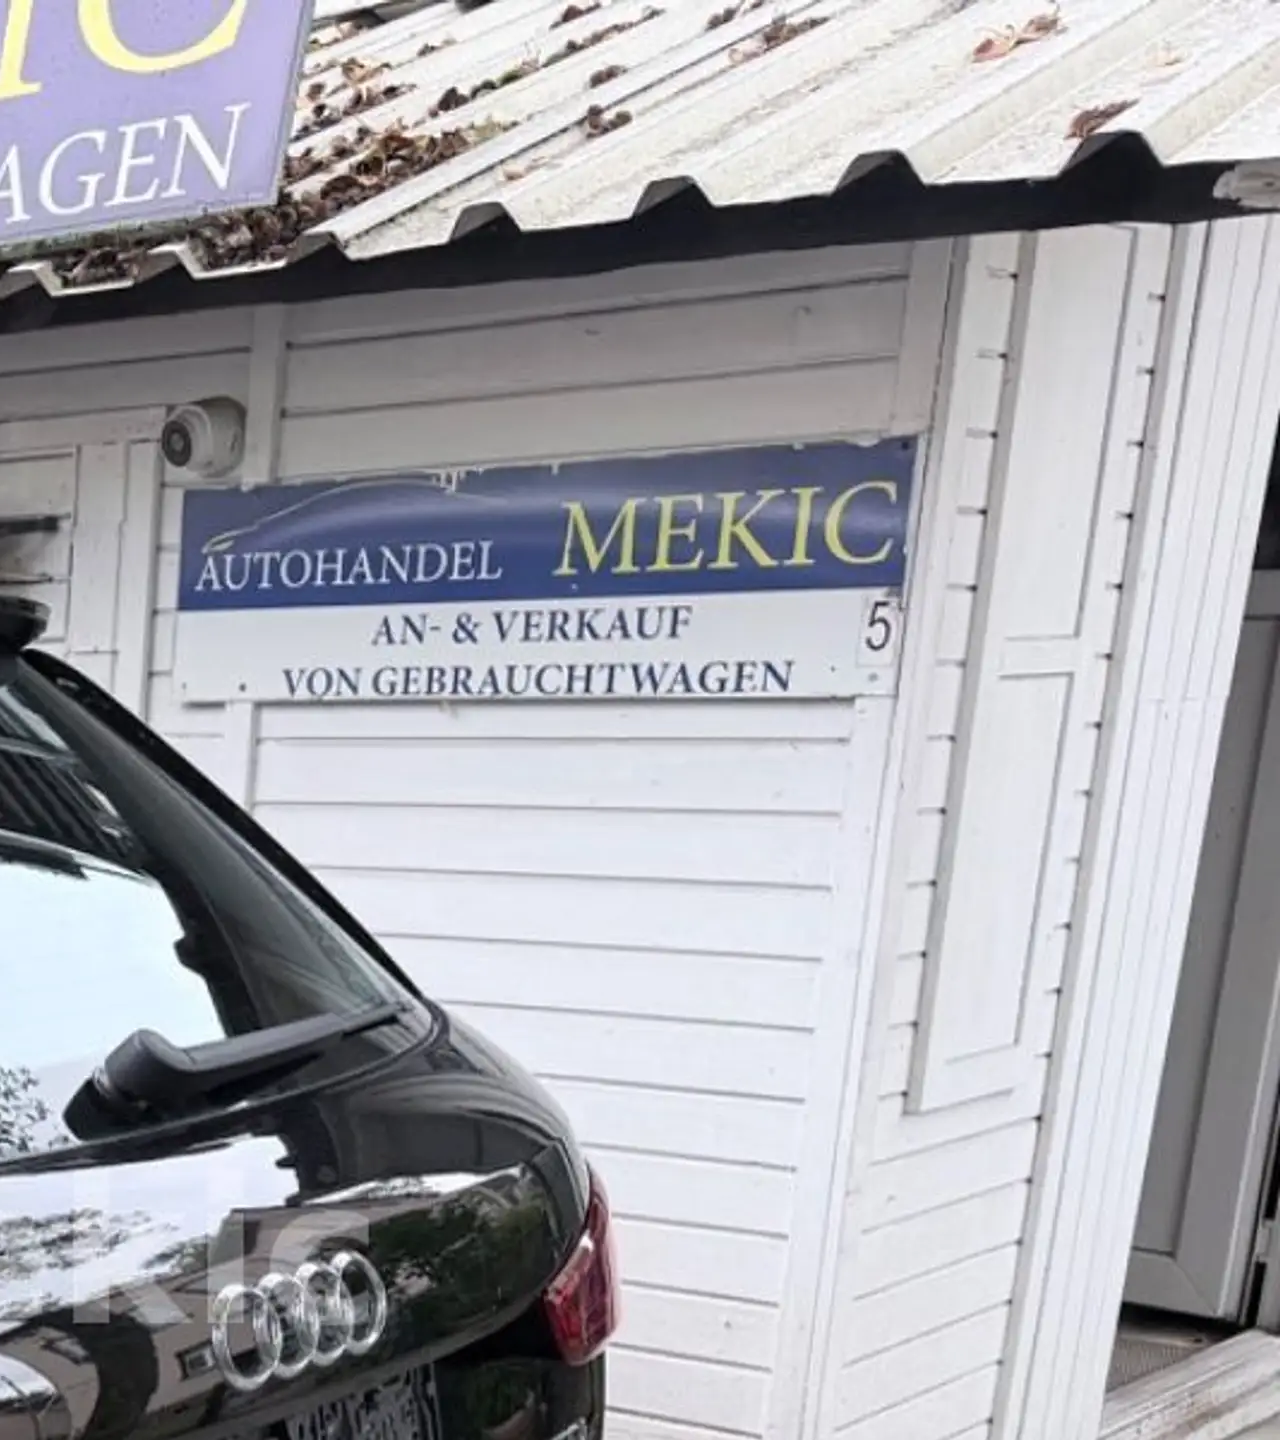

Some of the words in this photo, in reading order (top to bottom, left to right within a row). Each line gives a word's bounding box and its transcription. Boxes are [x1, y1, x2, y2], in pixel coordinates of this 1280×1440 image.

[194, 540, 503, 593] AUTOHANDEL
[552, 480, 898, 577] MEKIC
[371, 613, 441, 646] AN-
[452, 612, 480, 644] &
[493, 604, 693, 644] VERKAUF
[865, 600, 891, 651] 5
[282, 667, 363, 701] VON
[371, 660, 794, 698] GEBRAUCHTWAGEN
